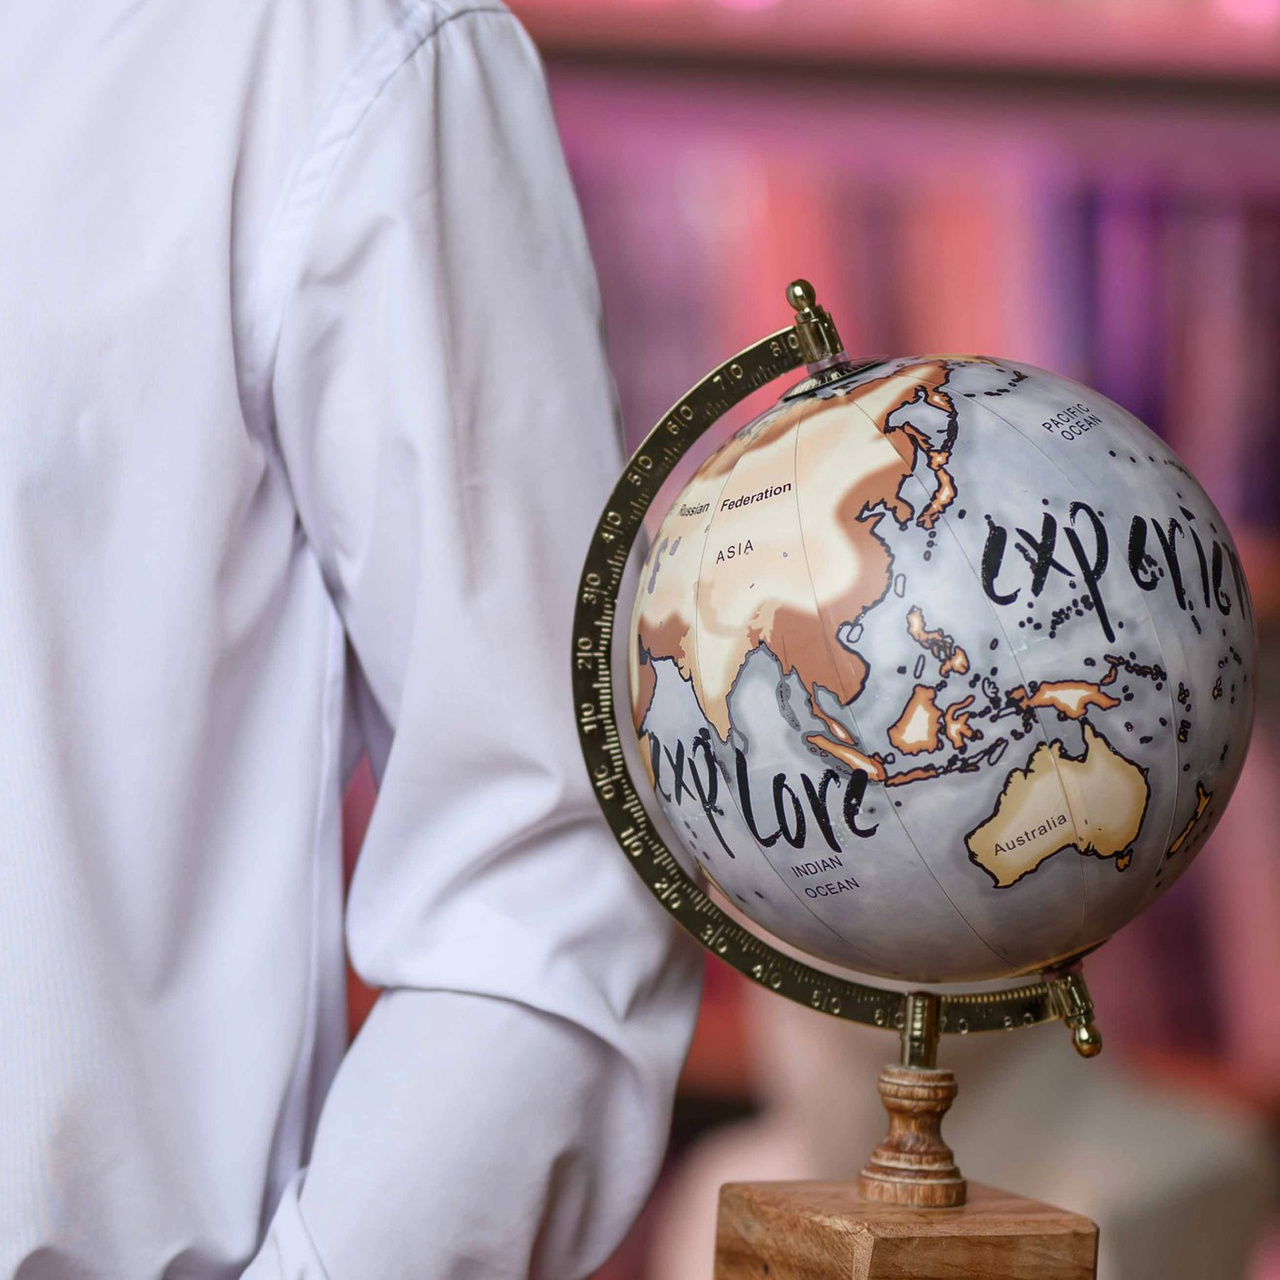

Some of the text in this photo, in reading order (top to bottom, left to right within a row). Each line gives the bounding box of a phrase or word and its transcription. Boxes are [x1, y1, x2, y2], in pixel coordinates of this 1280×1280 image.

[713, 363, 743, 390] 70
[666, 405, 694, 434] 60
[1041, 403, 1090, 433] PACIFIC
[1061, 414, 1103, 441] OCEAN
[626, 455, 653, 485] 50
[720, 482, 792, 512] Federation
[601, 511, 622, 543] 40
[716, 539, 754, 564] ASIA
[582, 573, 600, 605] 30
[576, 637, 592, 669] 20
[580, 702, 597, 733] 10
[994, 814, 1067, 856] Australia
[791, 855, 844, 878] INDIAN
[804, 877, 861, 899] OCEAN
